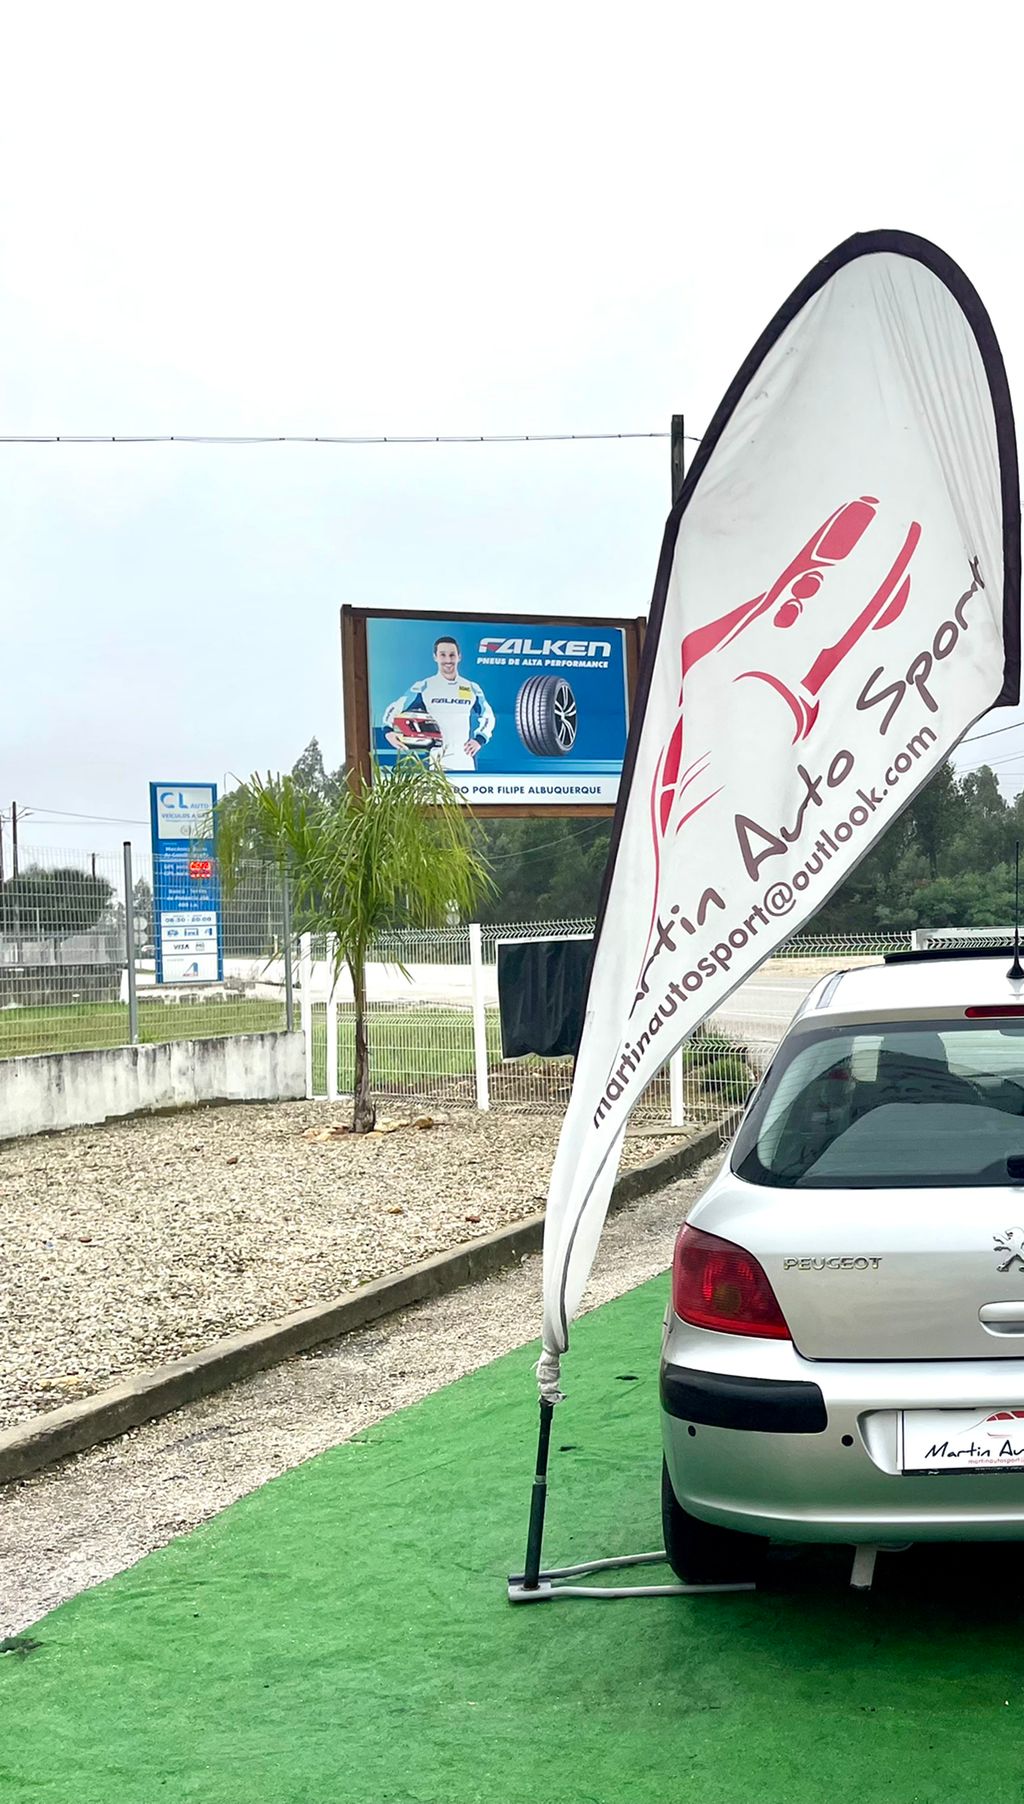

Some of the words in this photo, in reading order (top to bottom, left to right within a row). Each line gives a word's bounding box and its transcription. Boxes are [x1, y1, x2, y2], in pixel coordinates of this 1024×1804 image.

[478, 637, 612, 657] FALKEN
[476, 657, 507, 666] PNEUS
[508, 658, 521, 666] DE
[521, 659, 543, 667] ALTA
[544, 659, 609, 669] PERFORMANCE
[472, 786, 494, 794] POR
[497, 786, 525, 794] FILIPE
[528, 786, 602, 795] ALBUQUERQUE
[627, 887, 726, 1020] rtin
[734, 748, 855, 882] Auto
[856, 555, 985, 736] Sport
[160, 792, 189, 809] CL
[592, 725, 938, 1130] martinautosport@outlook.com
[783, 1255, 883, 1271] PEUGEOT
[924, 1441, 991, 1459] Martin
